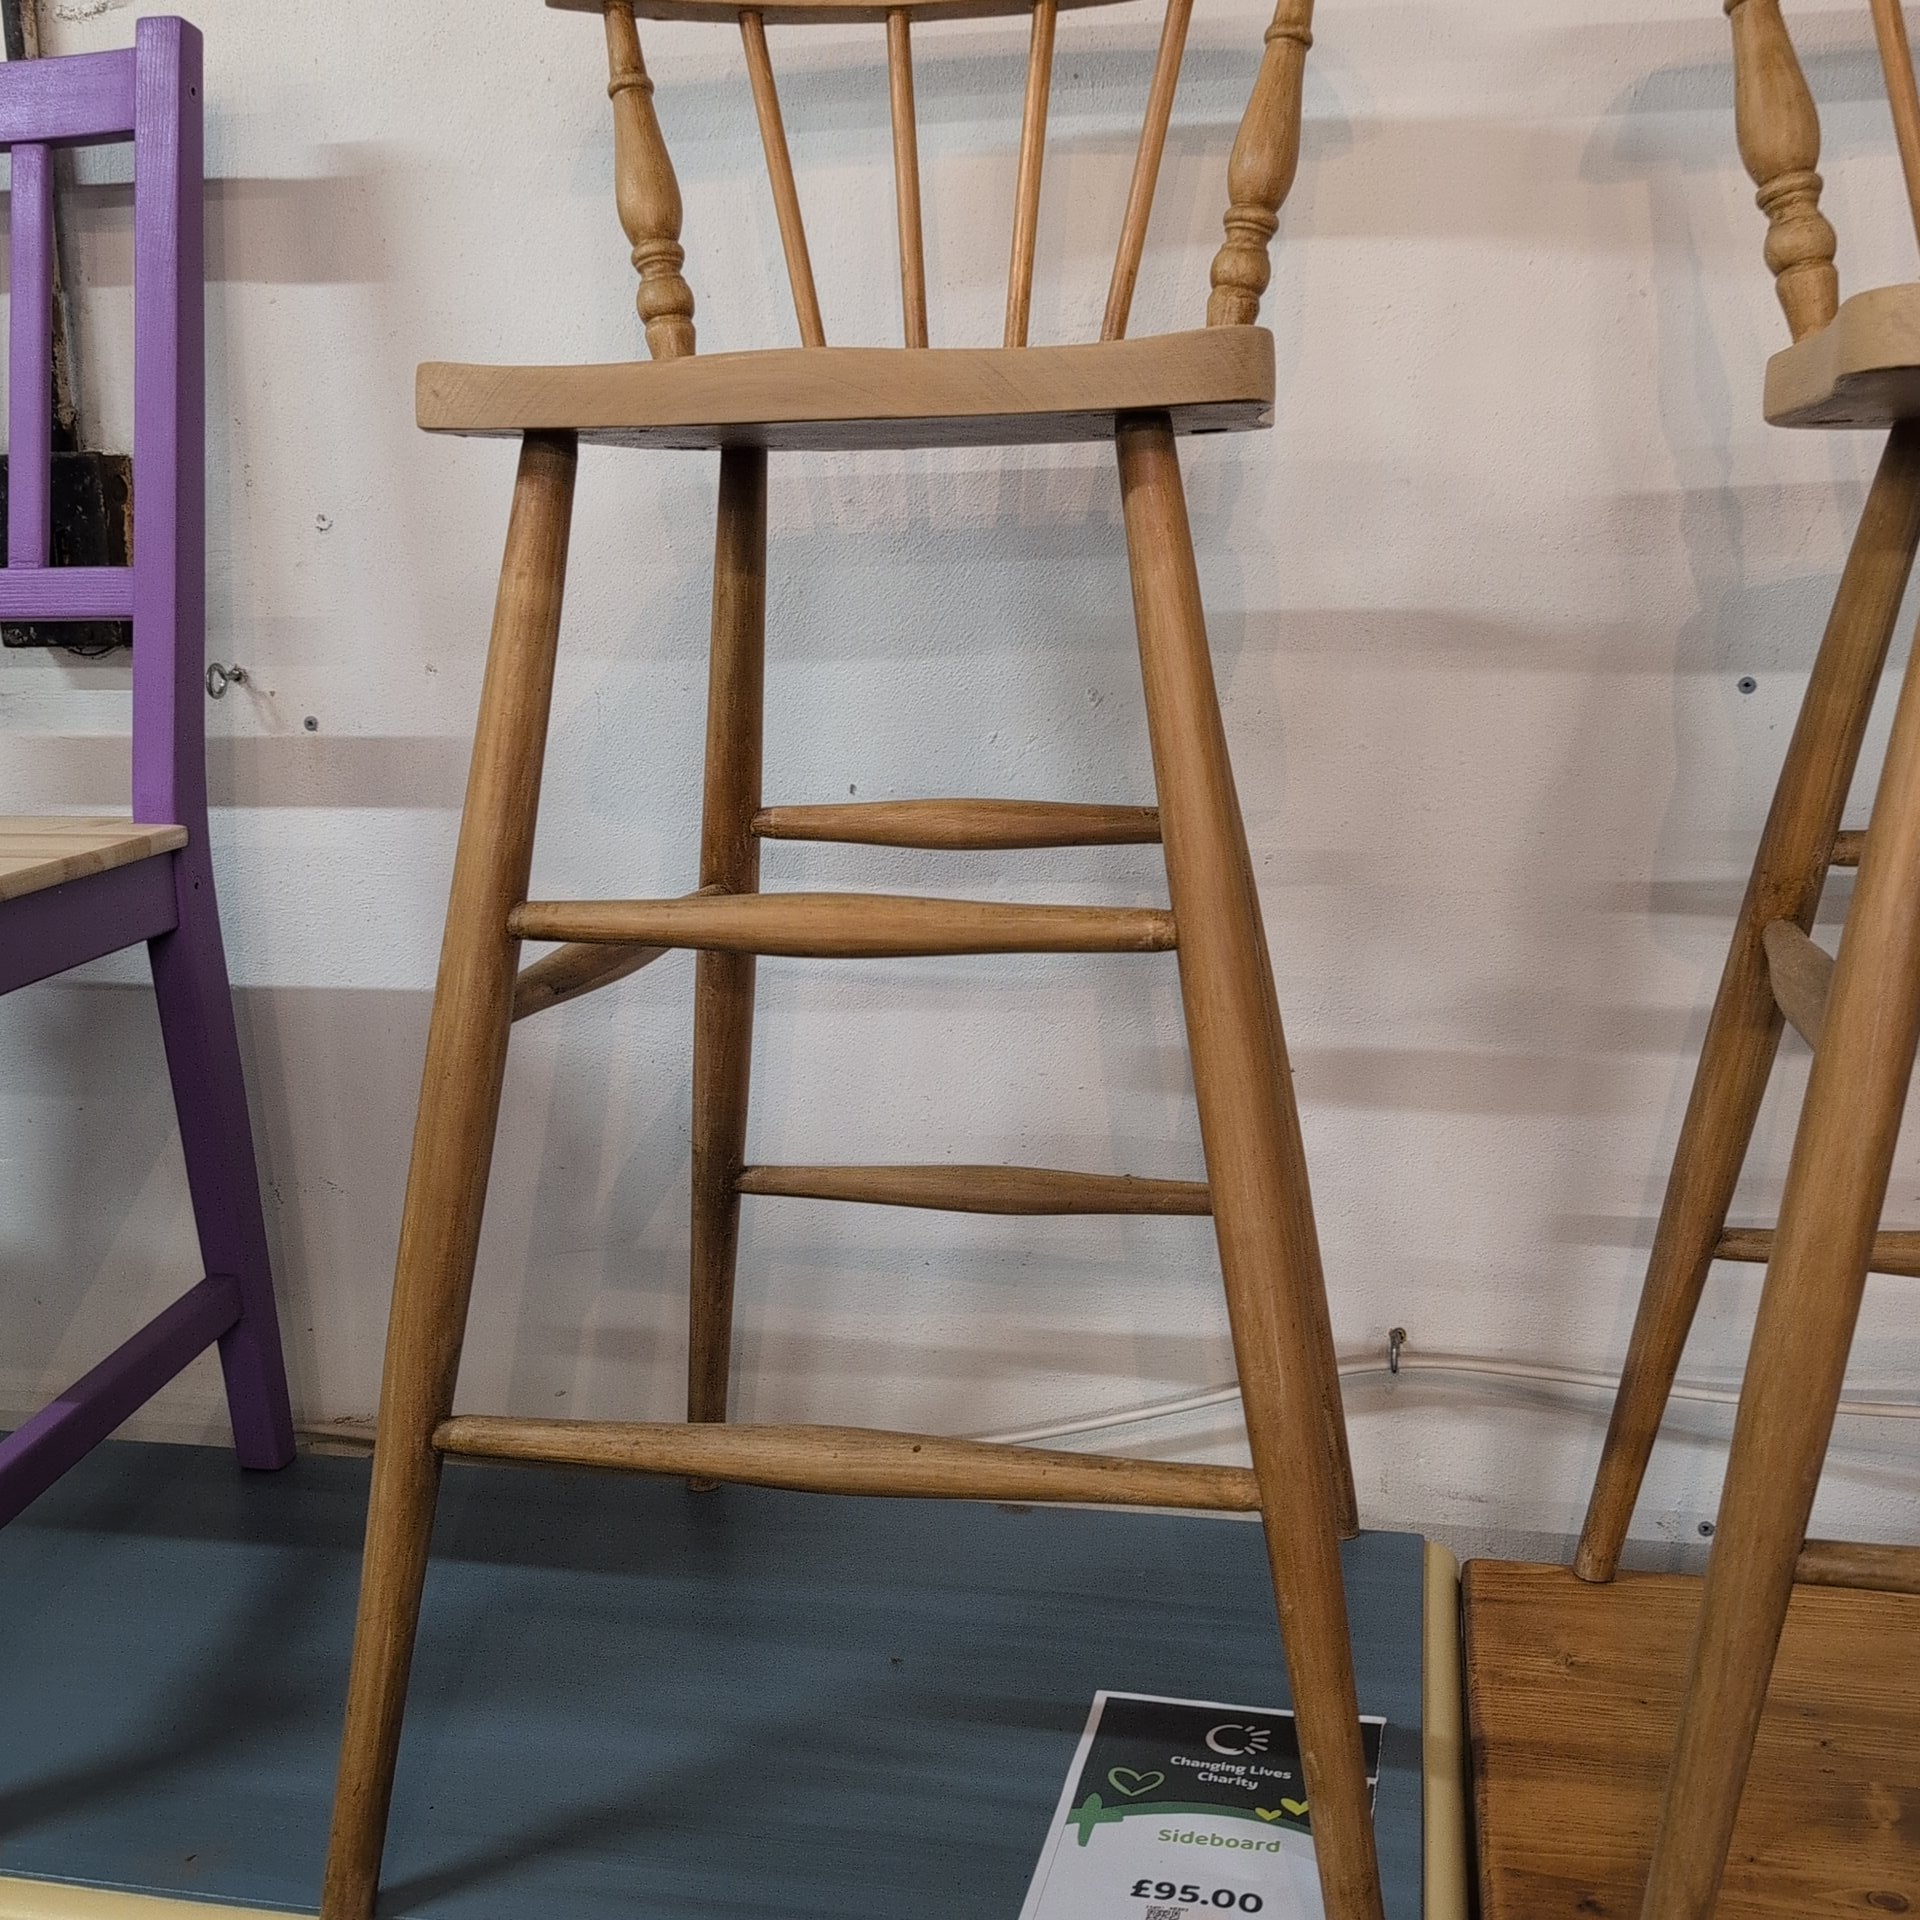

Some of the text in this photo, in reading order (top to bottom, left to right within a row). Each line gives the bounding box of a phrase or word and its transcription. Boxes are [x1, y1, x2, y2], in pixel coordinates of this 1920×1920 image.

[1170, 1756, 1292, 1780] Changing Lives
[1197, 1772, 1259, 1791] Charity
[1158, 1829, 1281, 1853] Sideboard
[1130, 1879, 1264, 1913] £95.00
